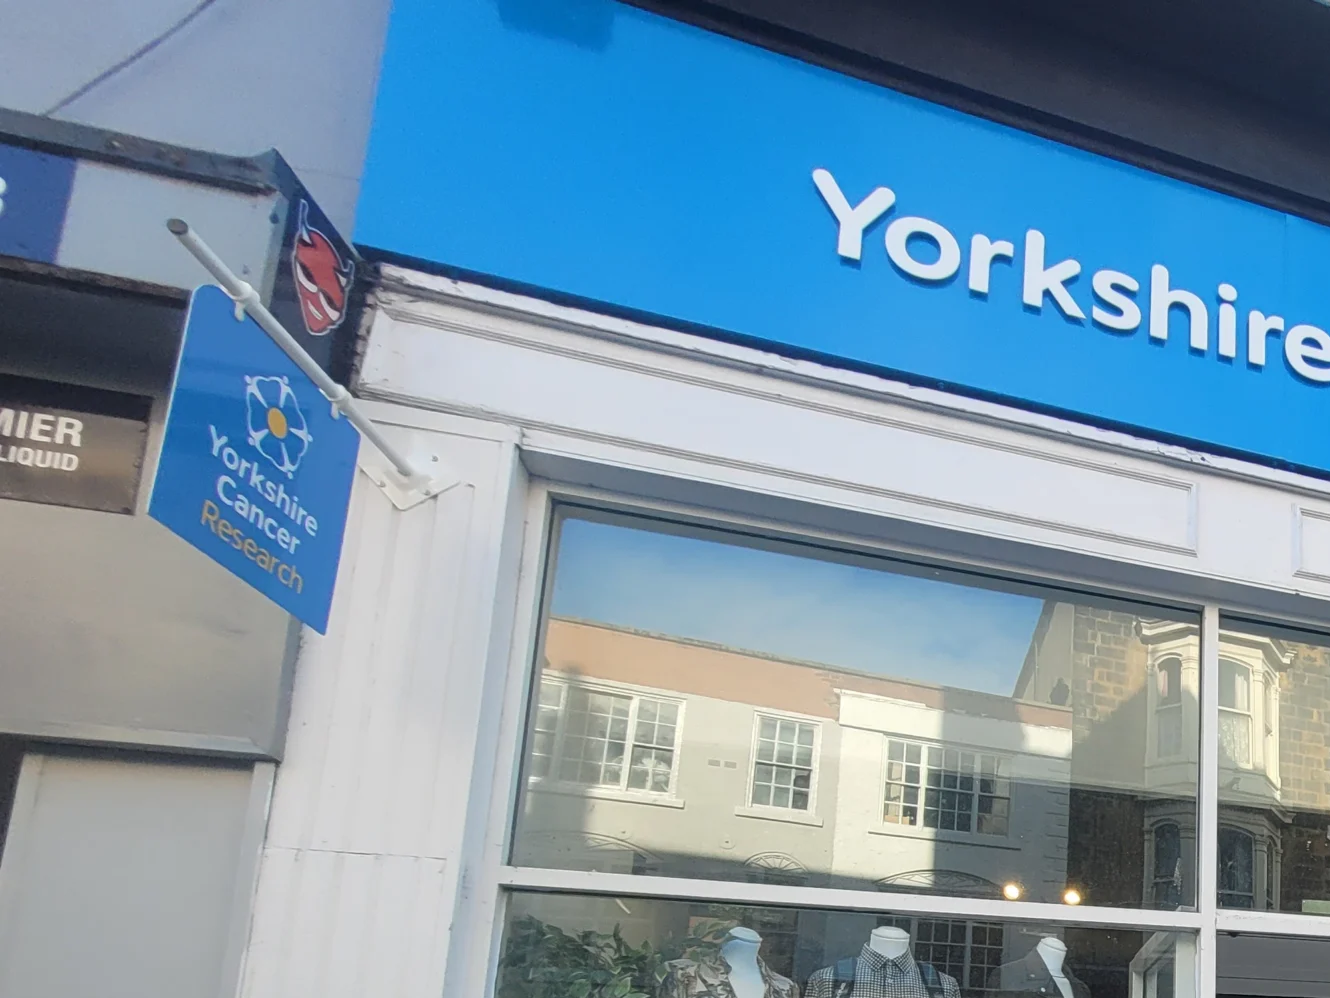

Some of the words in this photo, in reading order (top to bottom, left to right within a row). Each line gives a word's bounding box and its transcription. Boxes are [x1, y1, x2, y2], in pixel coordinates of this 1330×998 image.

[208, 426, 318, 537] Yorkshire
[216, 475, 301, 556] Cancer
[200, 500, 304, 594] Research
